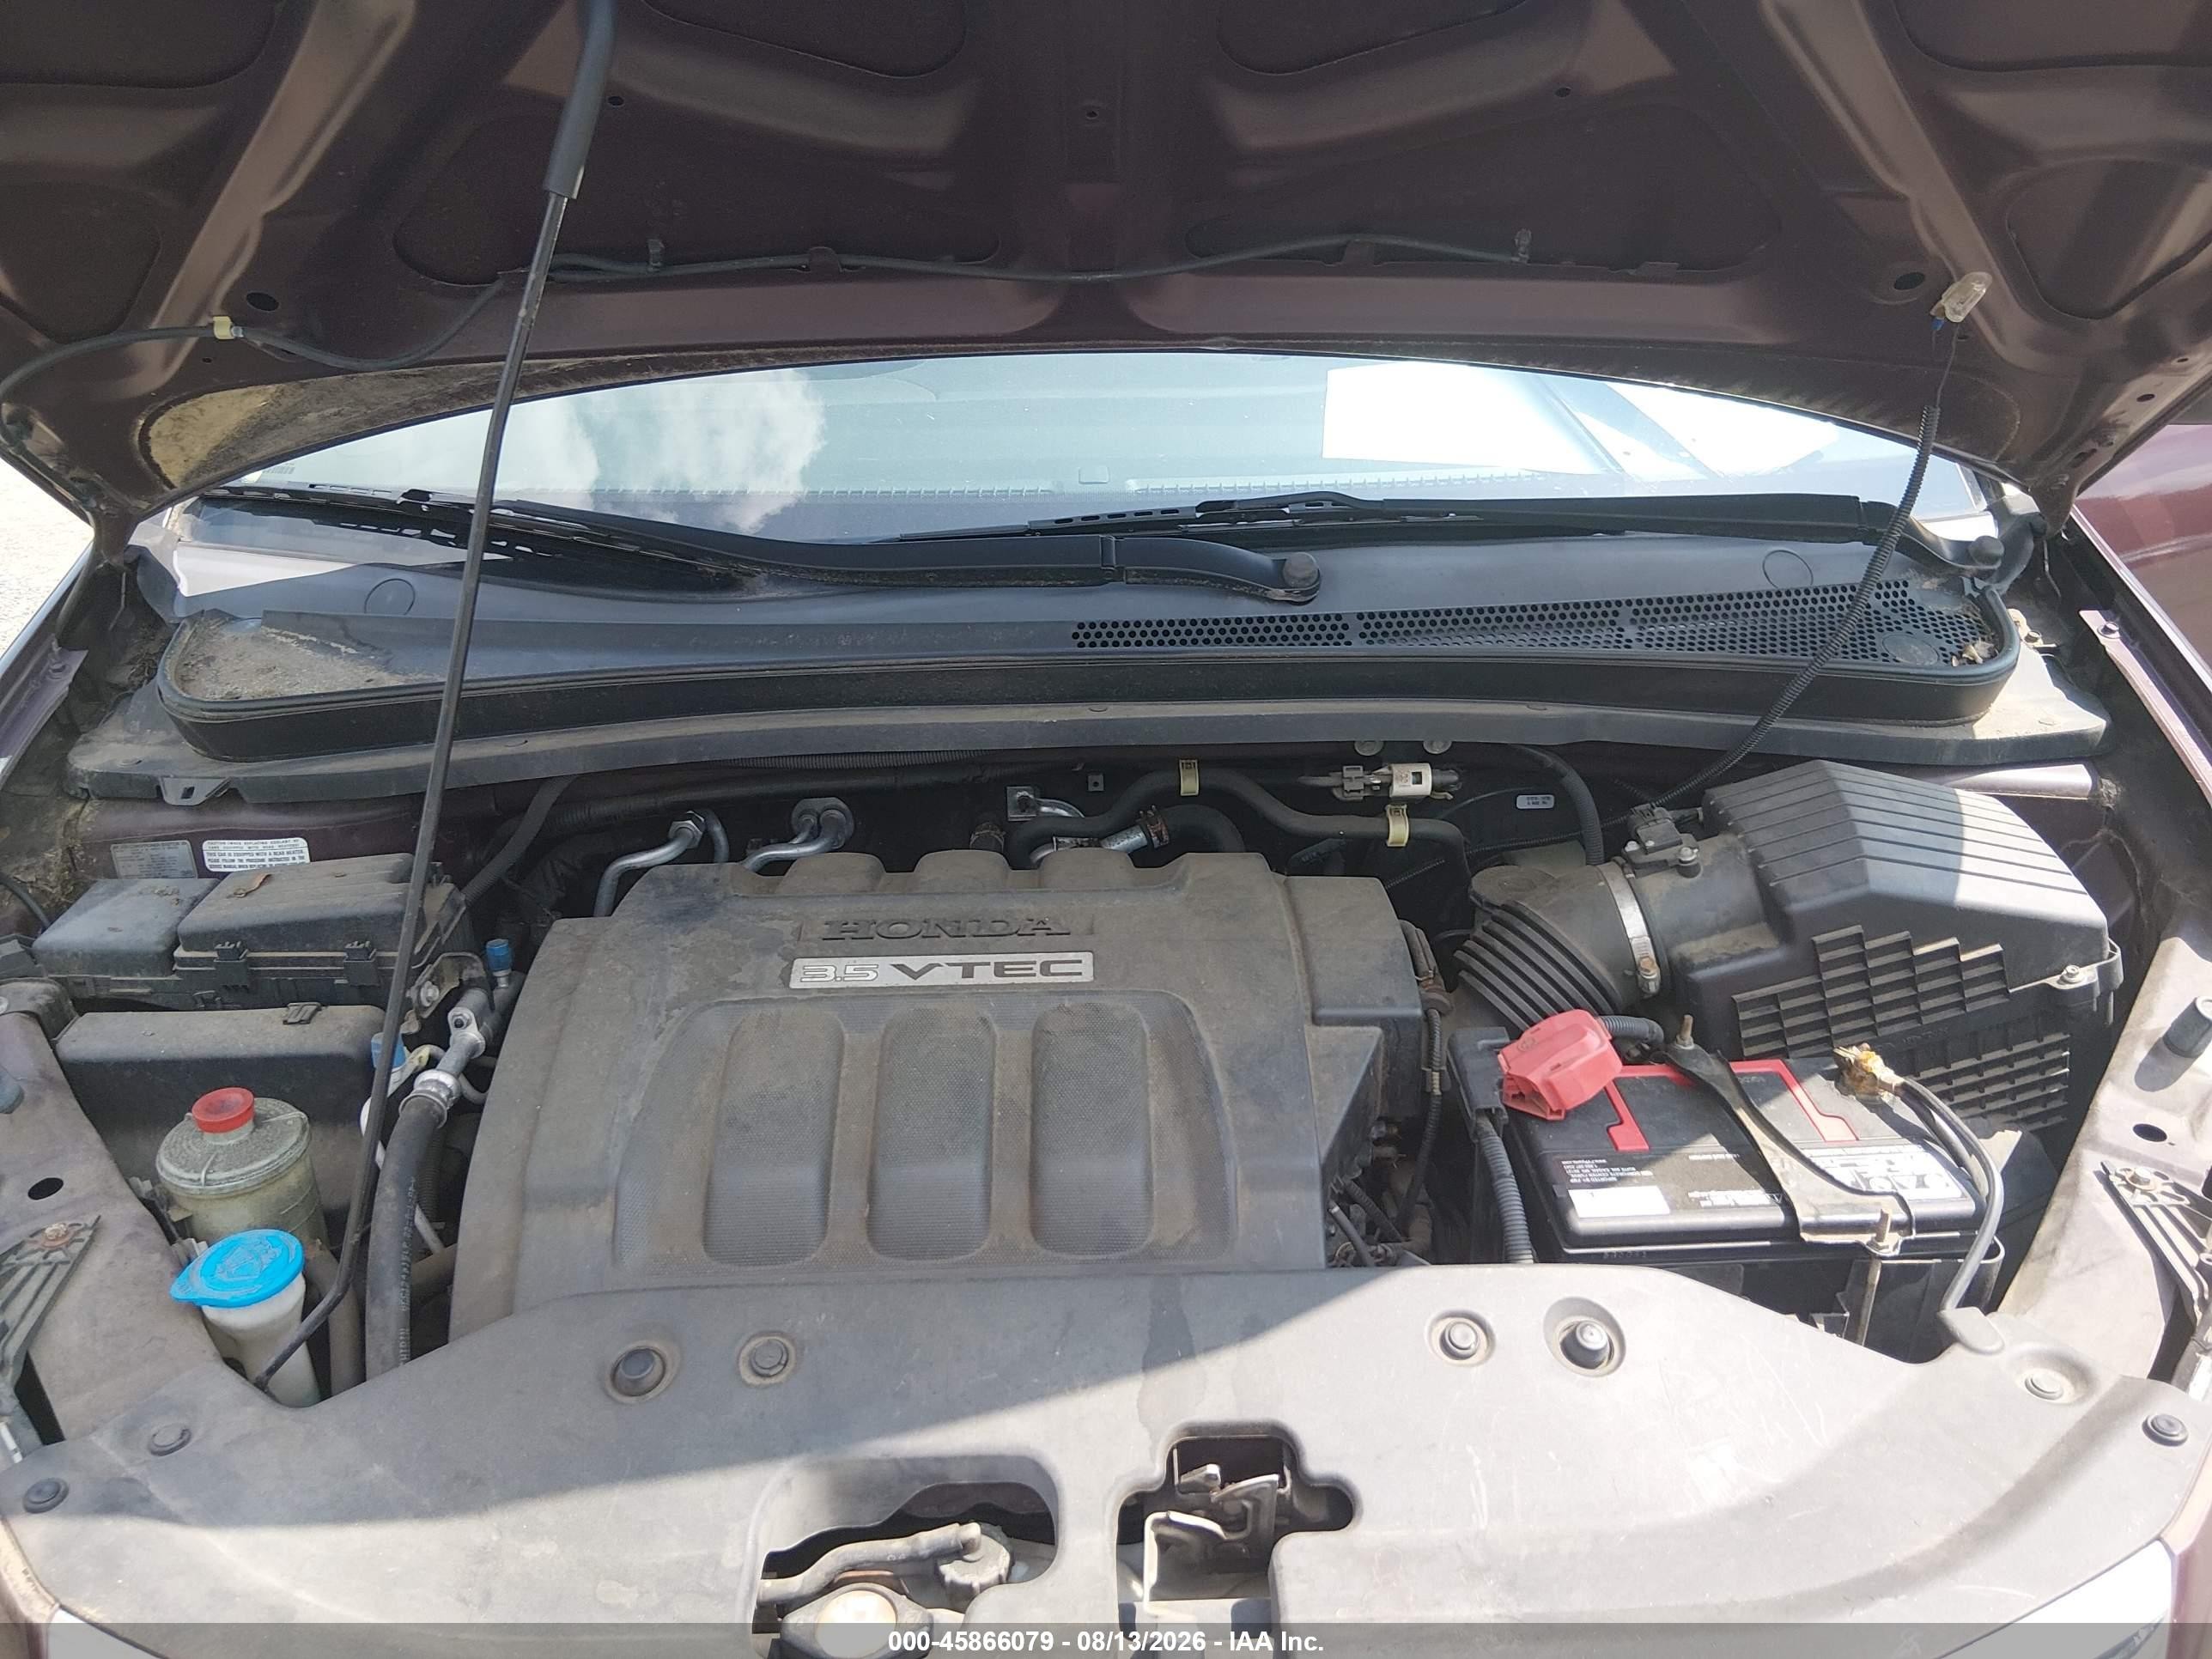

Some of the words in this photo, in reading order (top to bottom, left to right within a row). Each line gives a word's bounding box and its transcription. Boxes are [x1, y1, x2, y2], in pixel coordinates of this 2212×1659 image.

[822, 919, 1072, 941] HONDA
[799, 963, 880, 982] 3.5
[890, 959, 1083, 981] VTEC
